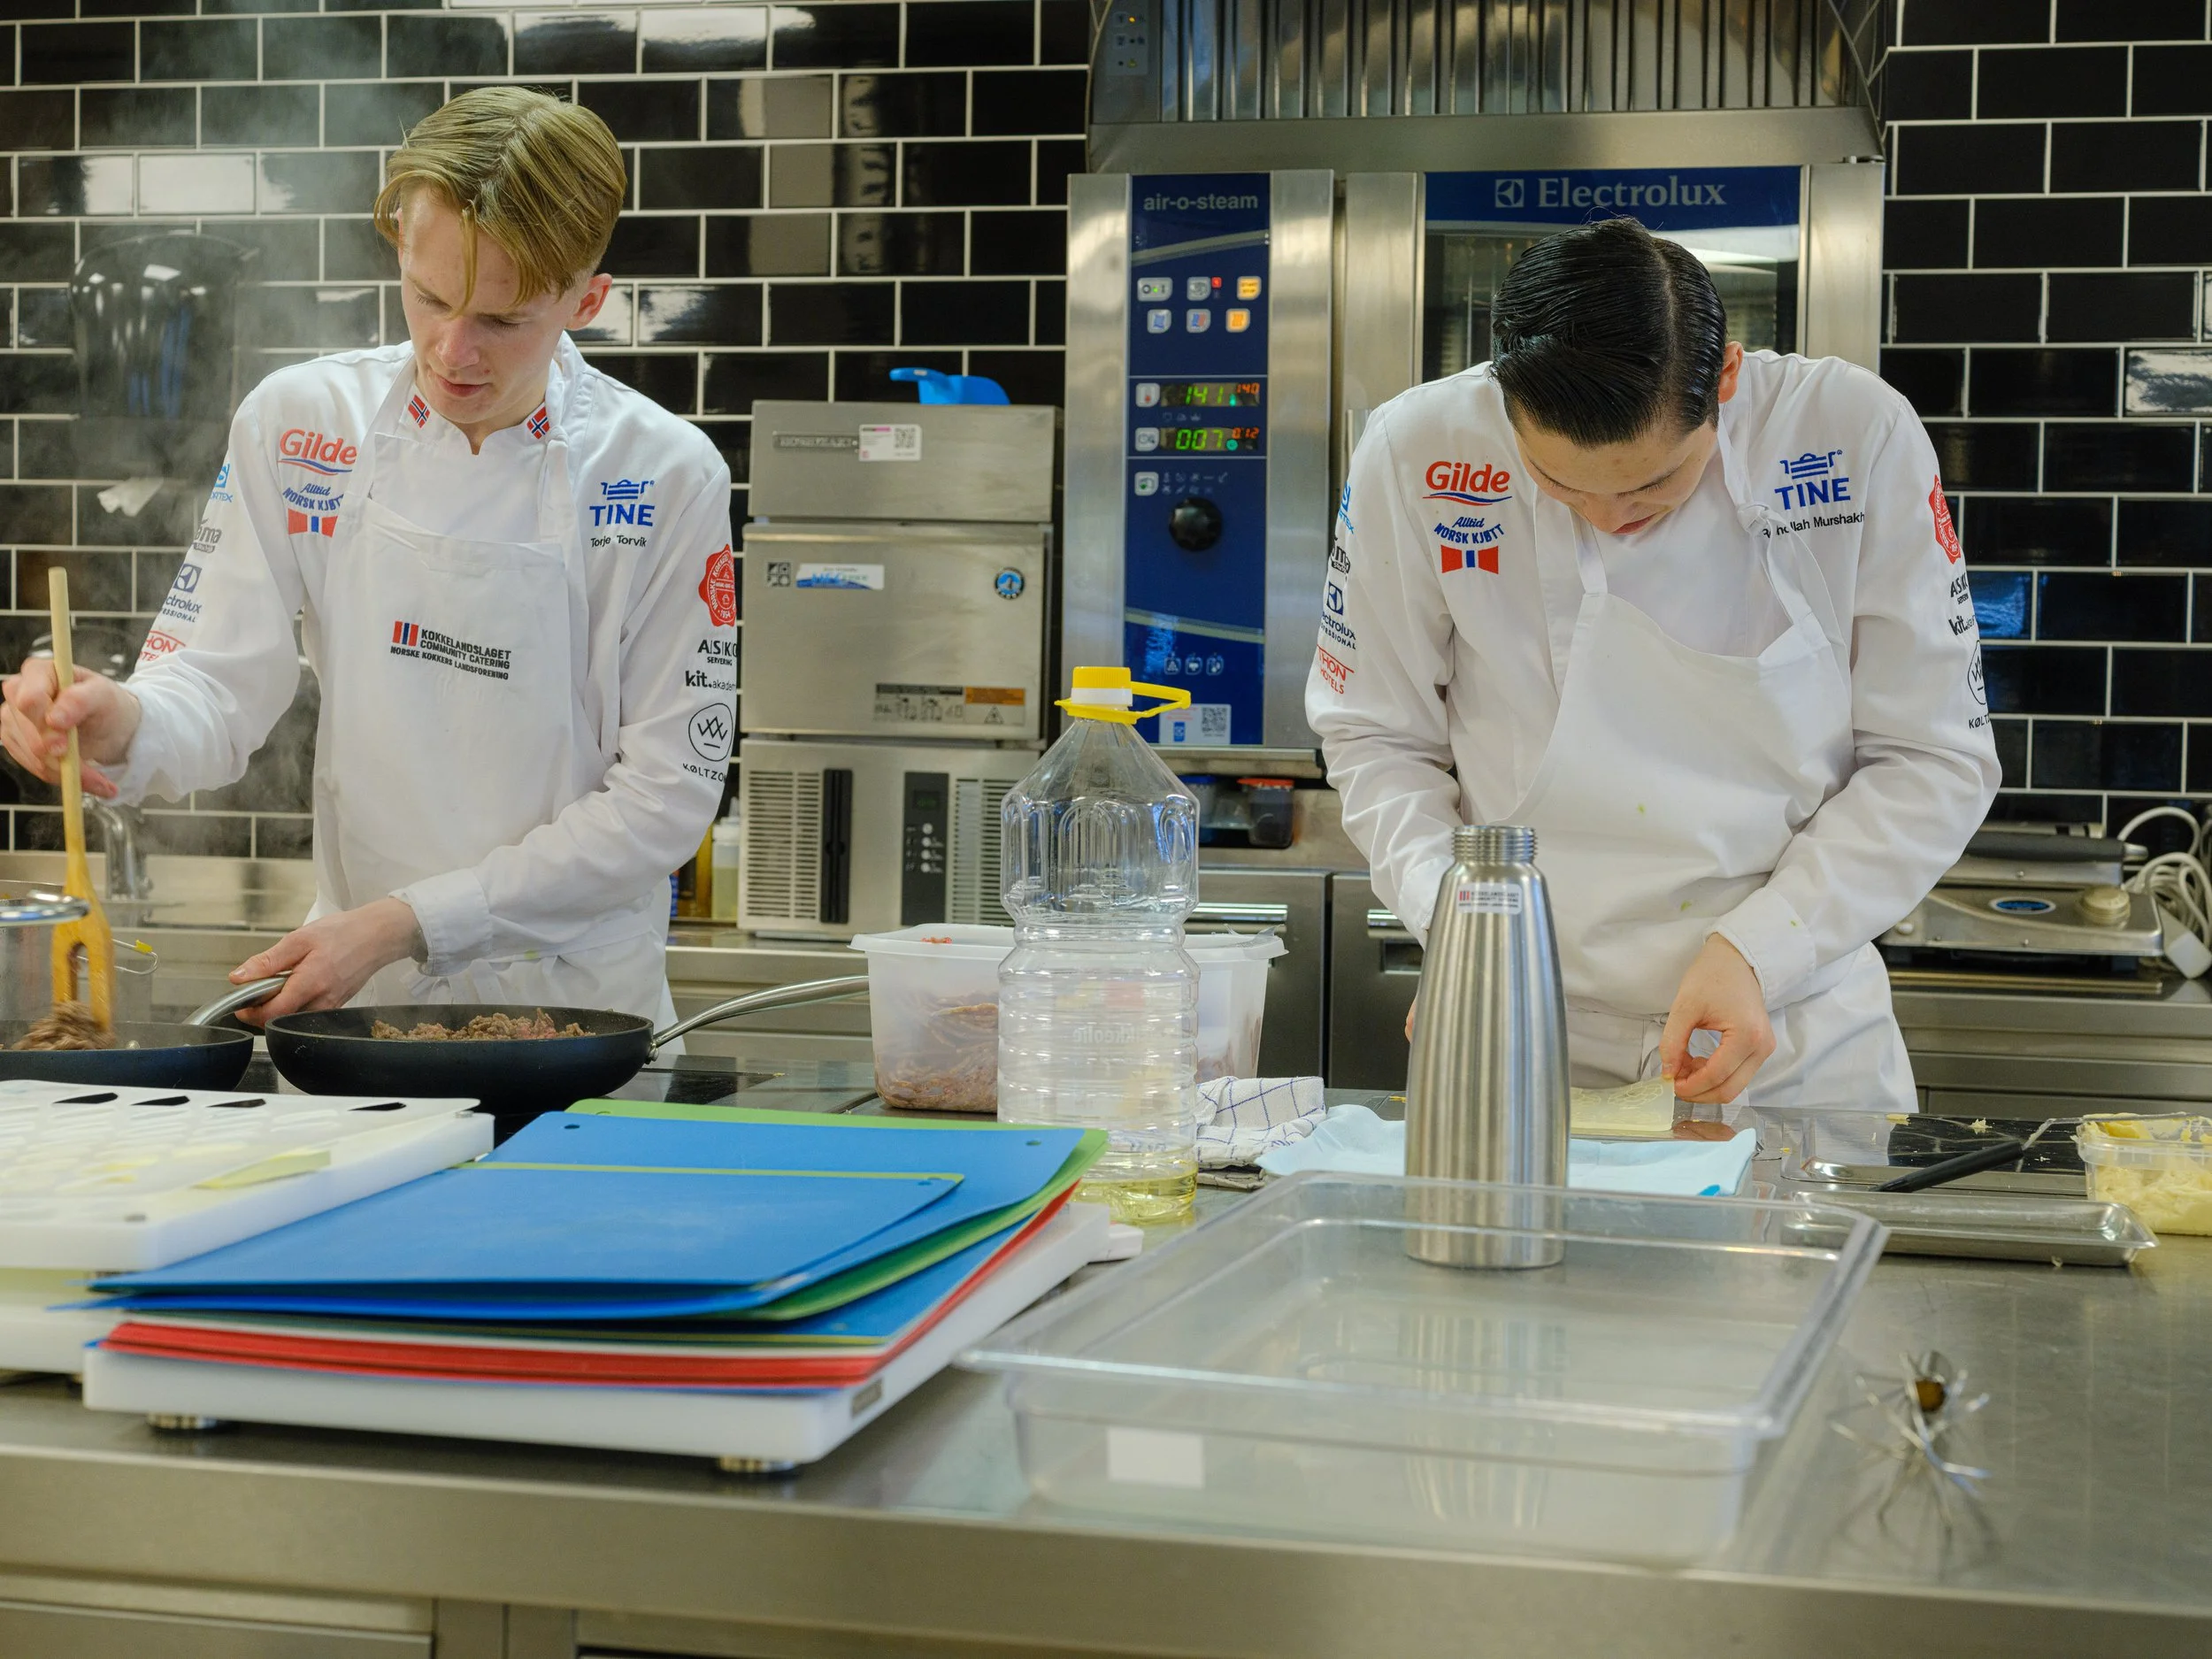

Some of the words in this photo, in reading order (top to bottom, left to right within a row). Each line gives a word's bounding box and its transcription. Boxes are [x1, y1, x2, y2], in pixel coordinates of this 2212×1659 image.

[1143, 194, 1259, 211] air-o-steam
[1538, 176, 1726, 207] Electrolux
[280, 428, 357, 465] Gilde
[1425, 460, 1510, 493] Gilde
[282, 487, 315, 510] NORSK
[300, 482, 331, 496] Alltid
[1774, 477, 1851, 511] TINE
[589, 503, 656, 527] TINE
[1451, 516, 1485, 528] Alltid
[590, 535, 611, 548] Torje
[616, 534, 647, 548] Torvik
[1433, 522, 1470, 544] NORSK
[1471, 523, 1505, 544] KJØTT
[162, 607, 196, 623] ESSIONAL
[165, 595, 203, 614] ctrolux
[145, 635, 177, 653] HON
[420, 640, 467, 661] COMMUNITY
[469, 654, 511, 670] CATERING
[421, 628, 511, 660] KOKKELANDSLAGET
[390, 645, 420, 658] NORSKE
[421, 651, 453, 666] KOKKERS
[454, 660, 510, 680] LANDSFORENING
